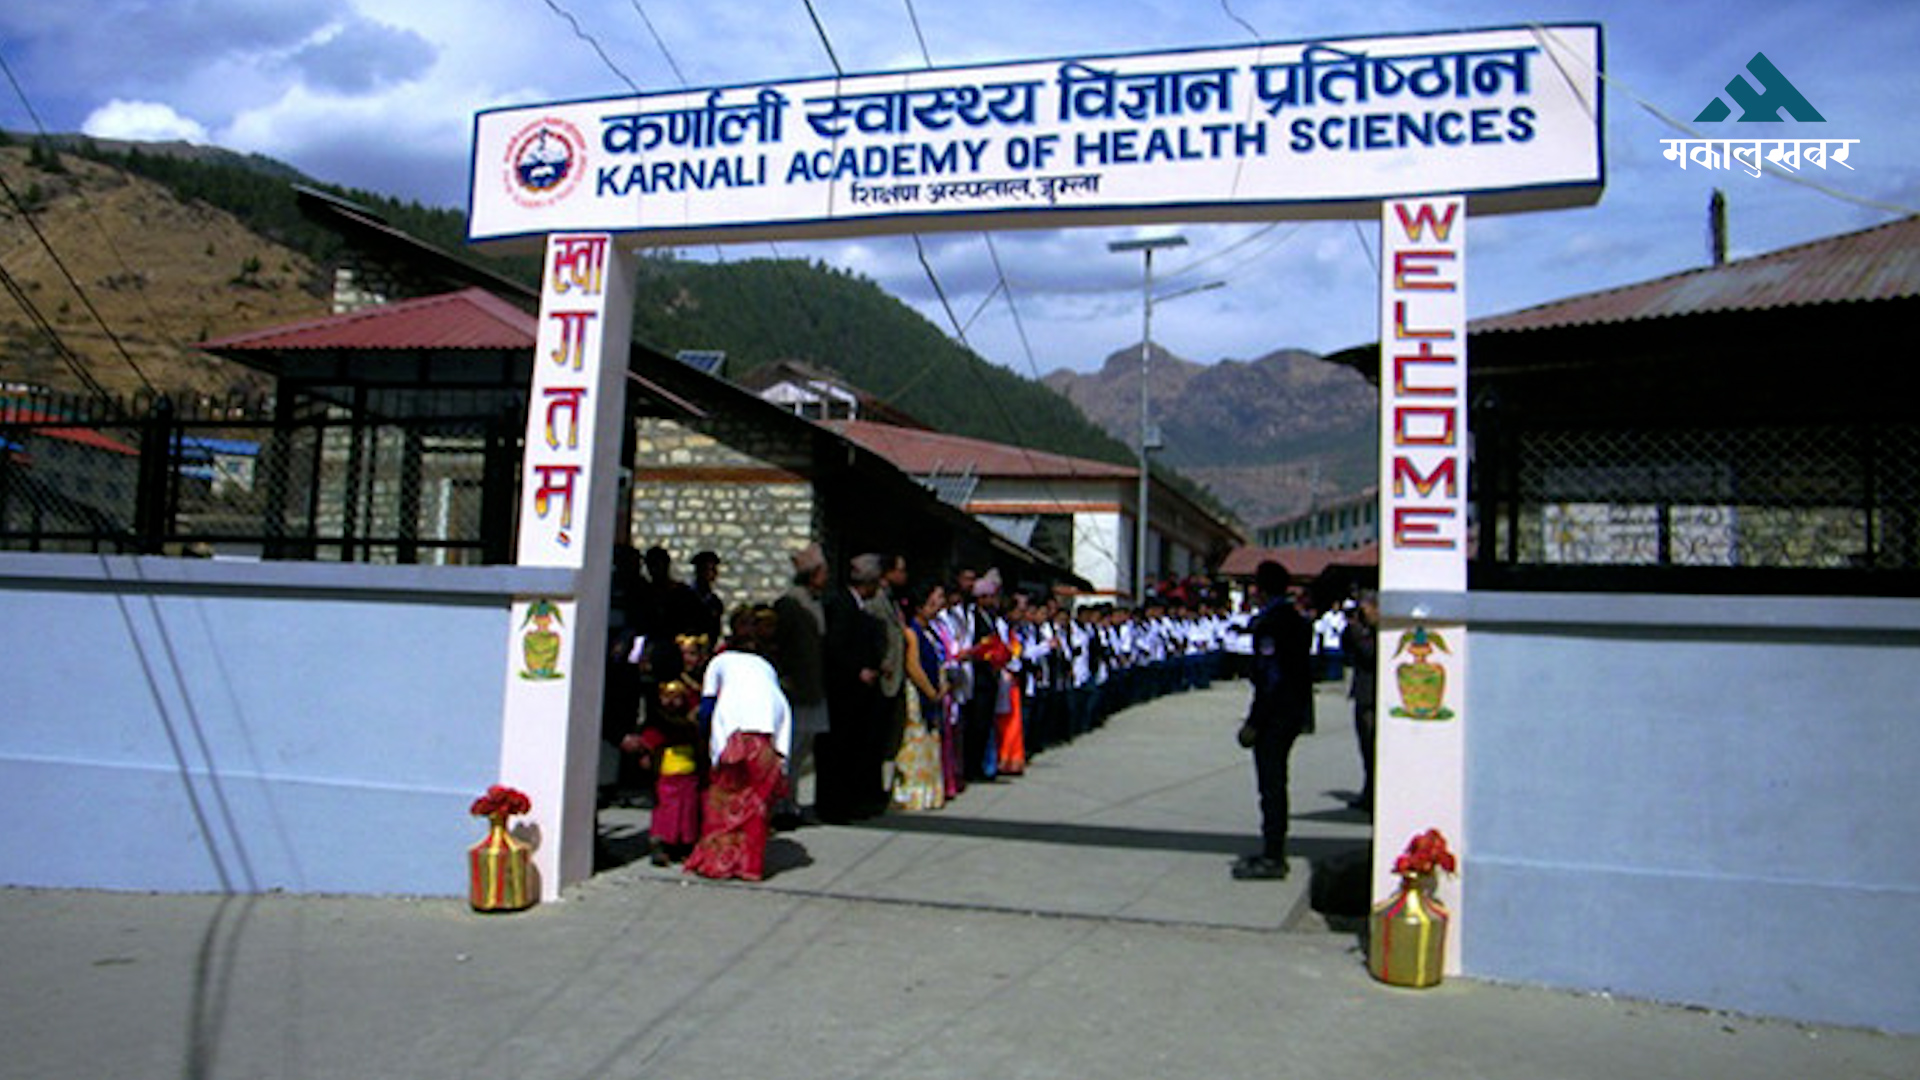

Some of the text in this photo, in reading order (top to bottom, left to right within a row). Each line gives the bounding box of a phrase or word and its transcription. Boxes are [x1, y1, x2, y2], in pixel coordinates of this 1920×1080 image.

[596, 154, 768, 198] KARNALI
[786, 137, 990, 185] ACADEMY
[1006, 134, 1058, 171] OF
[1074, 121, 1268, 167] HEALTH
[1289, 107, 1537, 153] SCIENCES
[600, 42, 1540, 156] कर्णाली स्वास्थ्य विज्ञान प्रतिष्ठान
[1394, 202, 1459, 550] WELCOME
